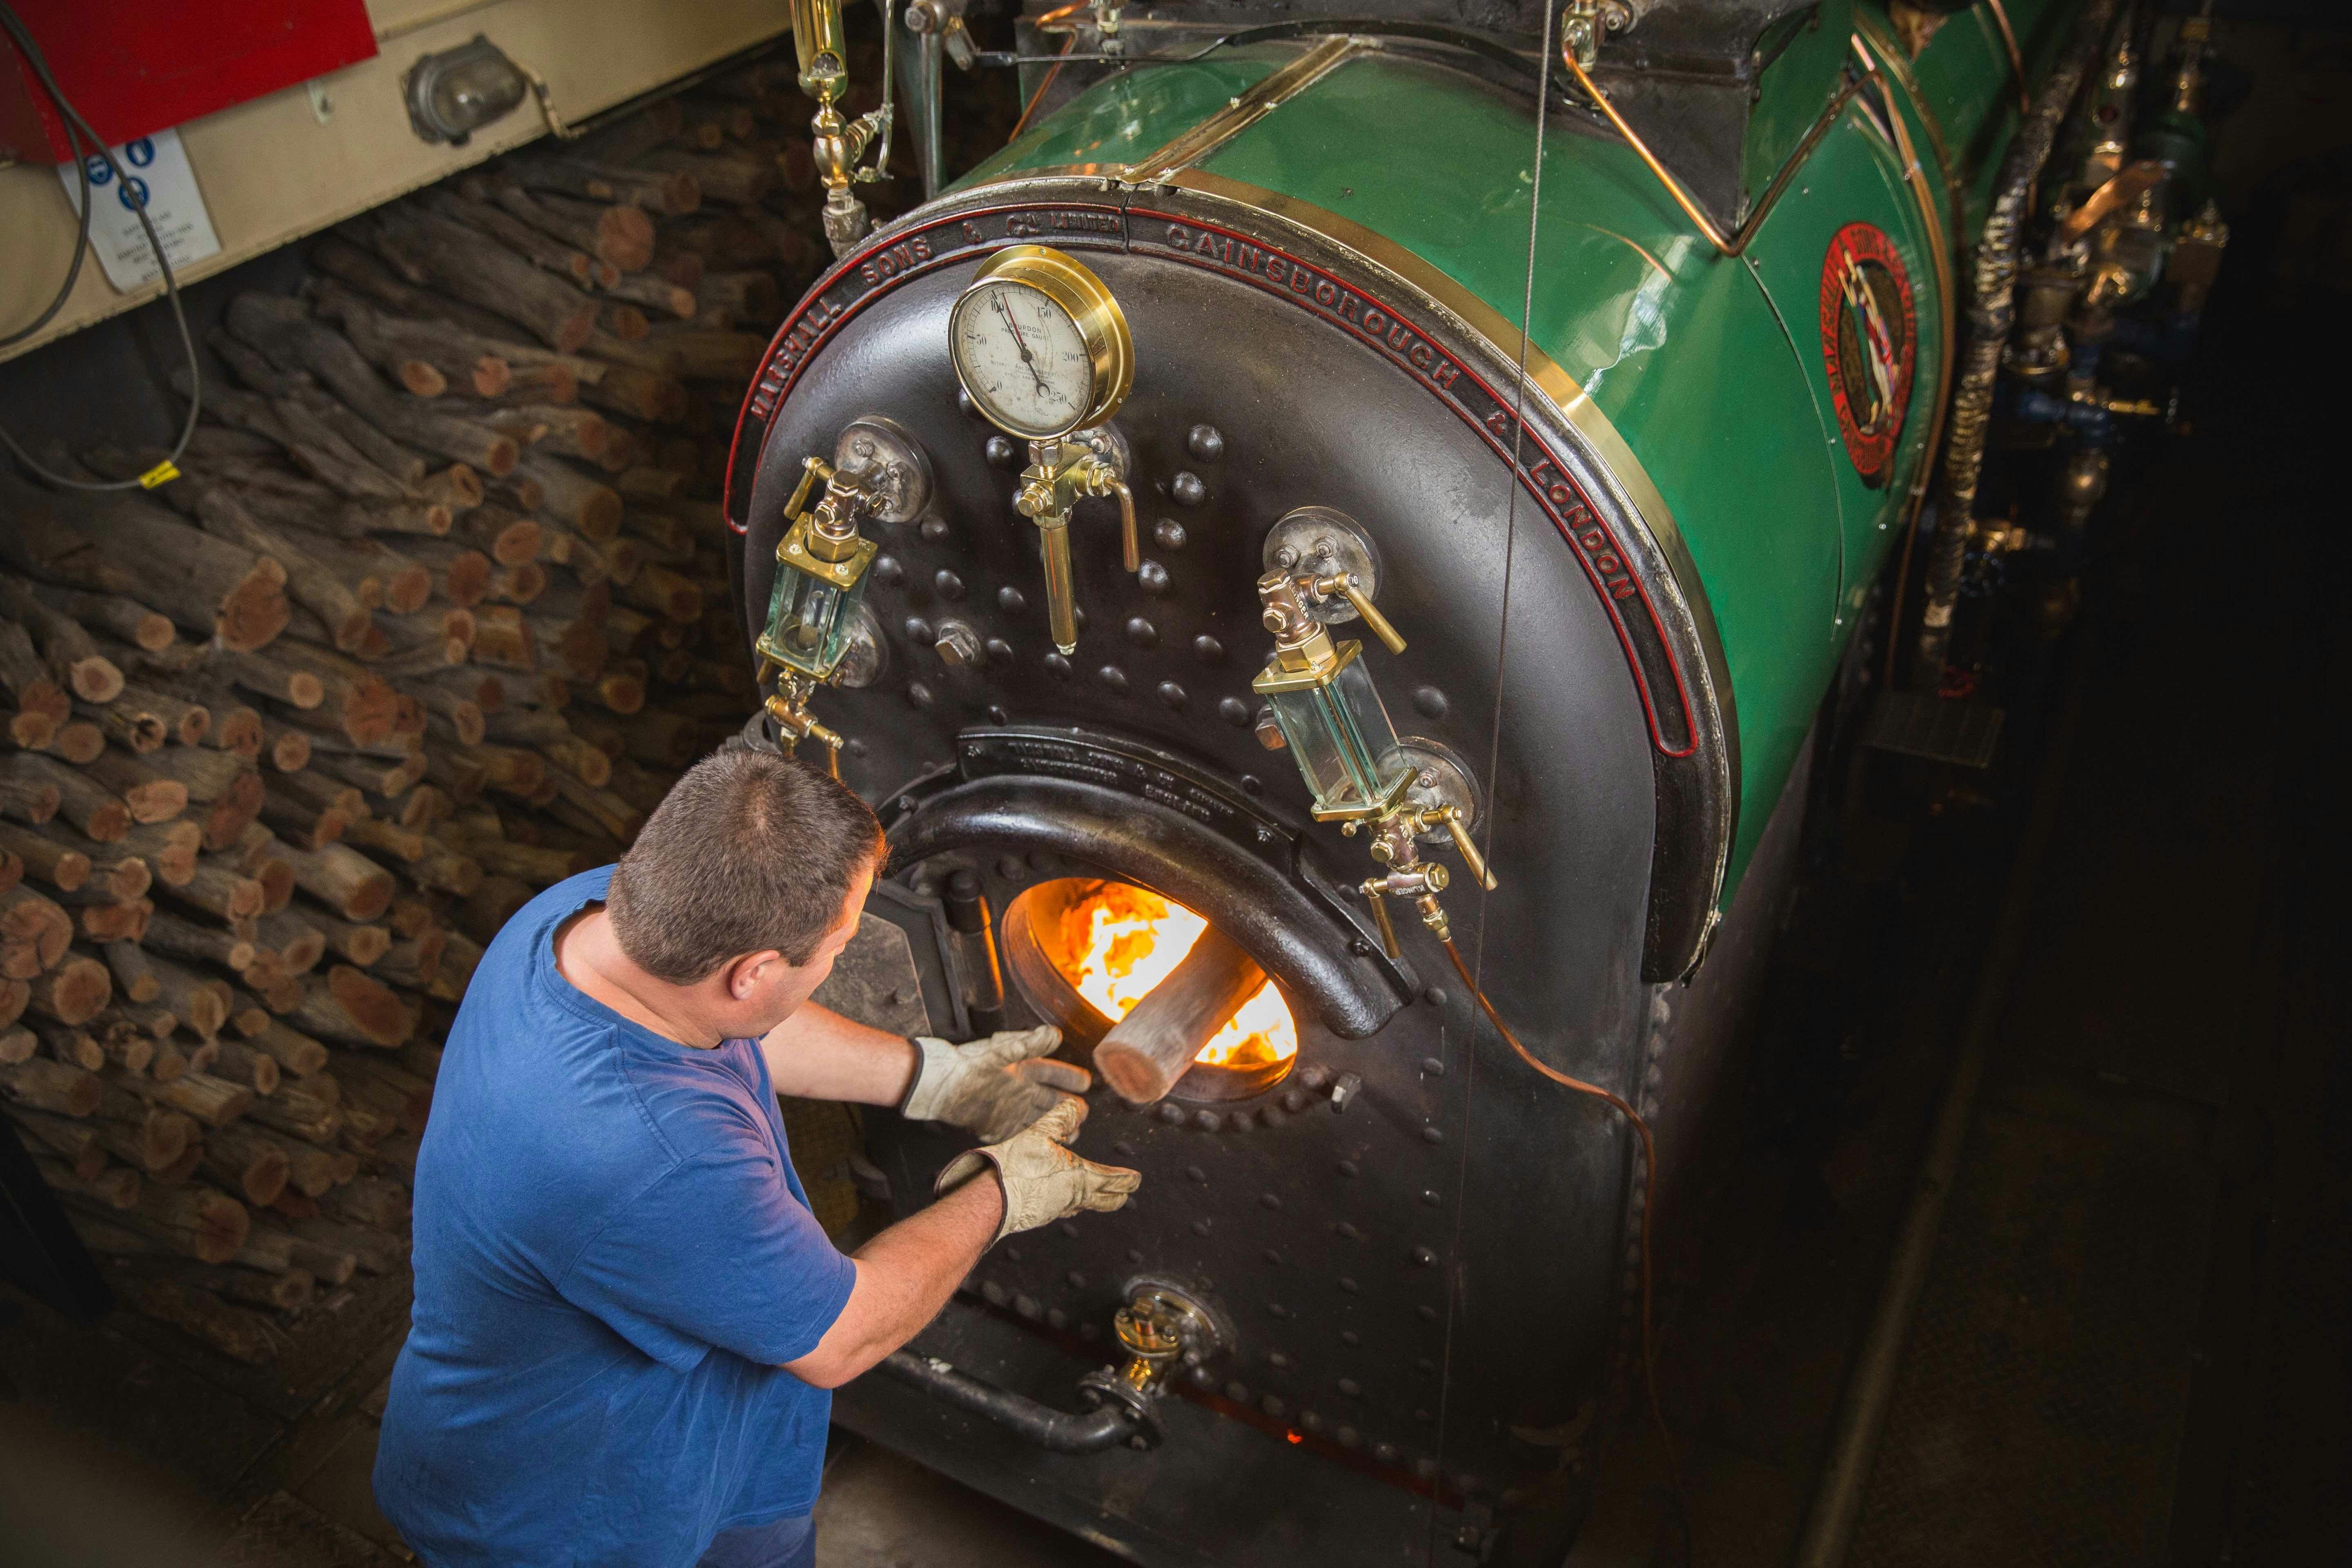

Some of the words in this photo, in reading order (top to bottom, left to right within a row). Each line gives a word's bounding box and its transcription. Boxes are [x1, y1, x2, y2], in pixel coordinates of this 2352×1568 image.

[991, 301, 1004, 312] 100
[1038, 306, 1051, 319] 150
[1009, 323, 1041, 333] BURDON
[976, 334, 987, 346] 50
[1062, 350, 1078, 363] 200
[997, 379, 1002, 390] 0
[1051, 390, 1067, 403] 250
[751, 297, 842, 421] MARSHALL
[860, 238, 932, 286] SONS
[1051, 212, 1120, 233] LIMITED
[1166, 223, 1462, 391] GAINSBOROUGH
[1486, 412, 1509, 437] &
[1530, 457, 1635, 602] LONDON
[1395, 884, 1425, 895] KLINGER
